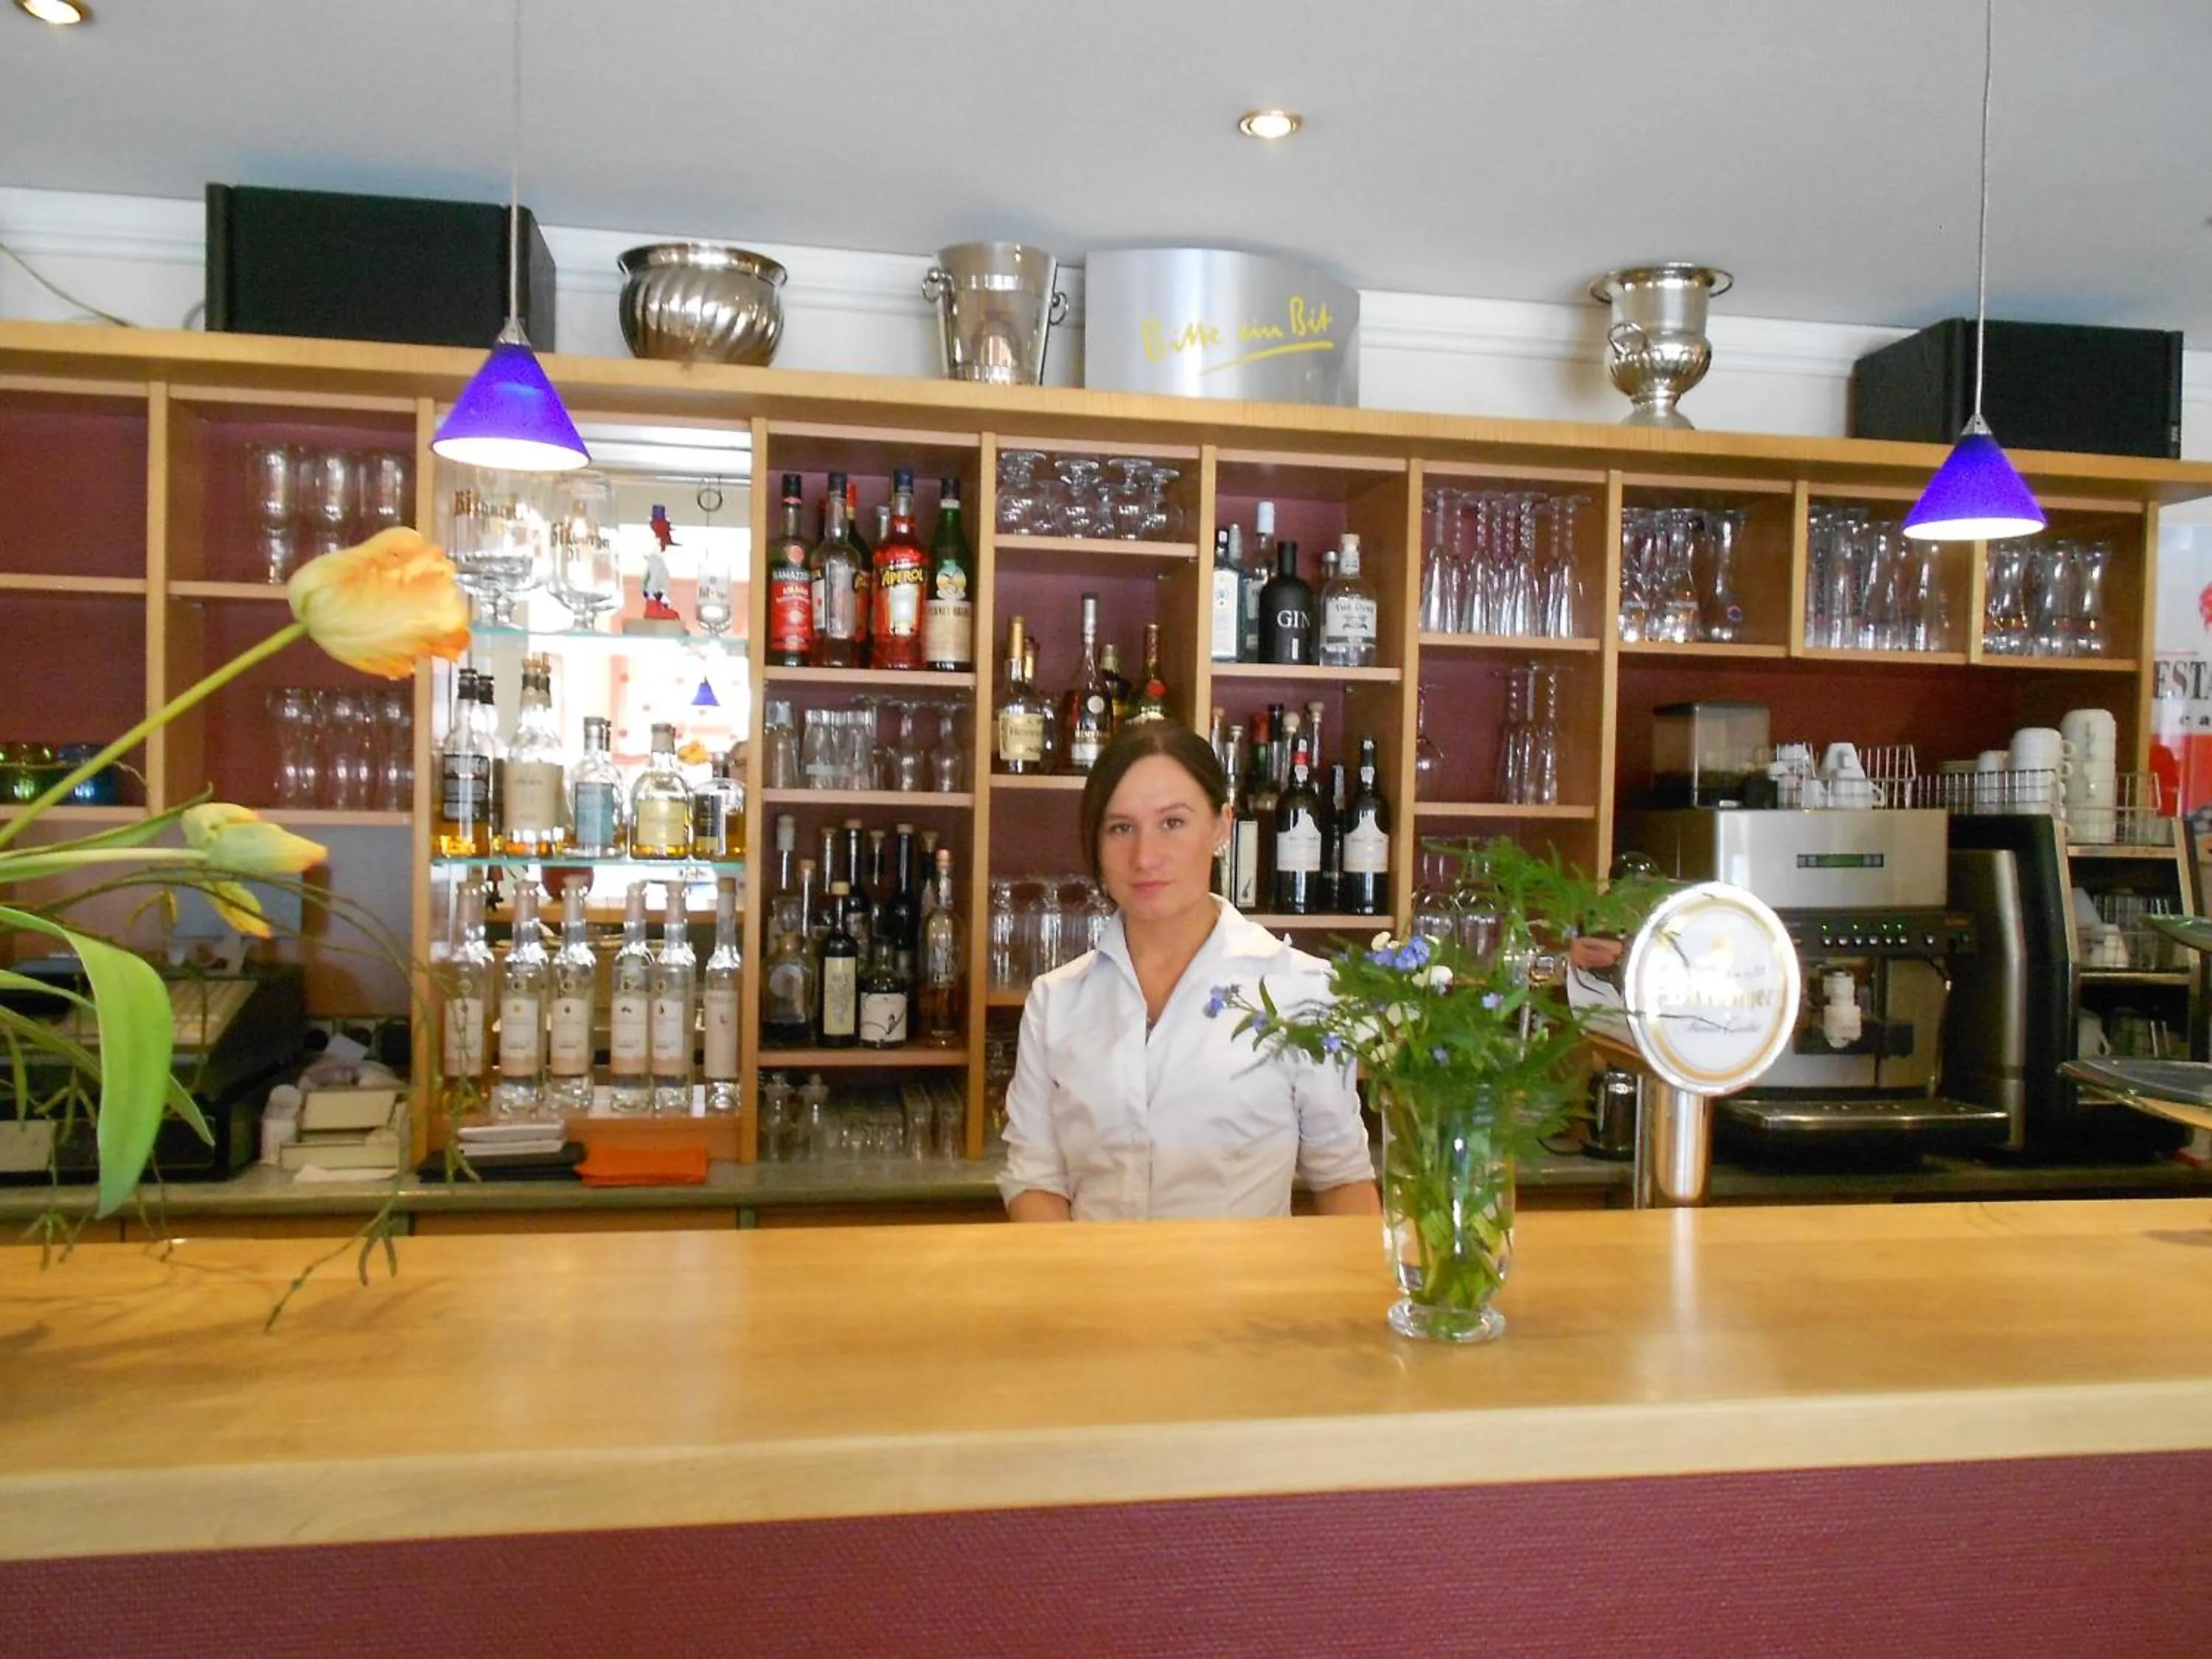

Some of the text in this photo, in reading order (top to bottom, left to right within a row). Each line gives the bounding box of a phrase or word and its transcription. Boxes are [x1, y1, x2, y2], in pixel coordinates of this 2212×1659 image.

[1290, 296, 1332, 335] Bit
[882, 566, 925, 587] APEROL
[1276, 609, 1310, 628] GIN
[2152, 659, 2212, 700] EST
